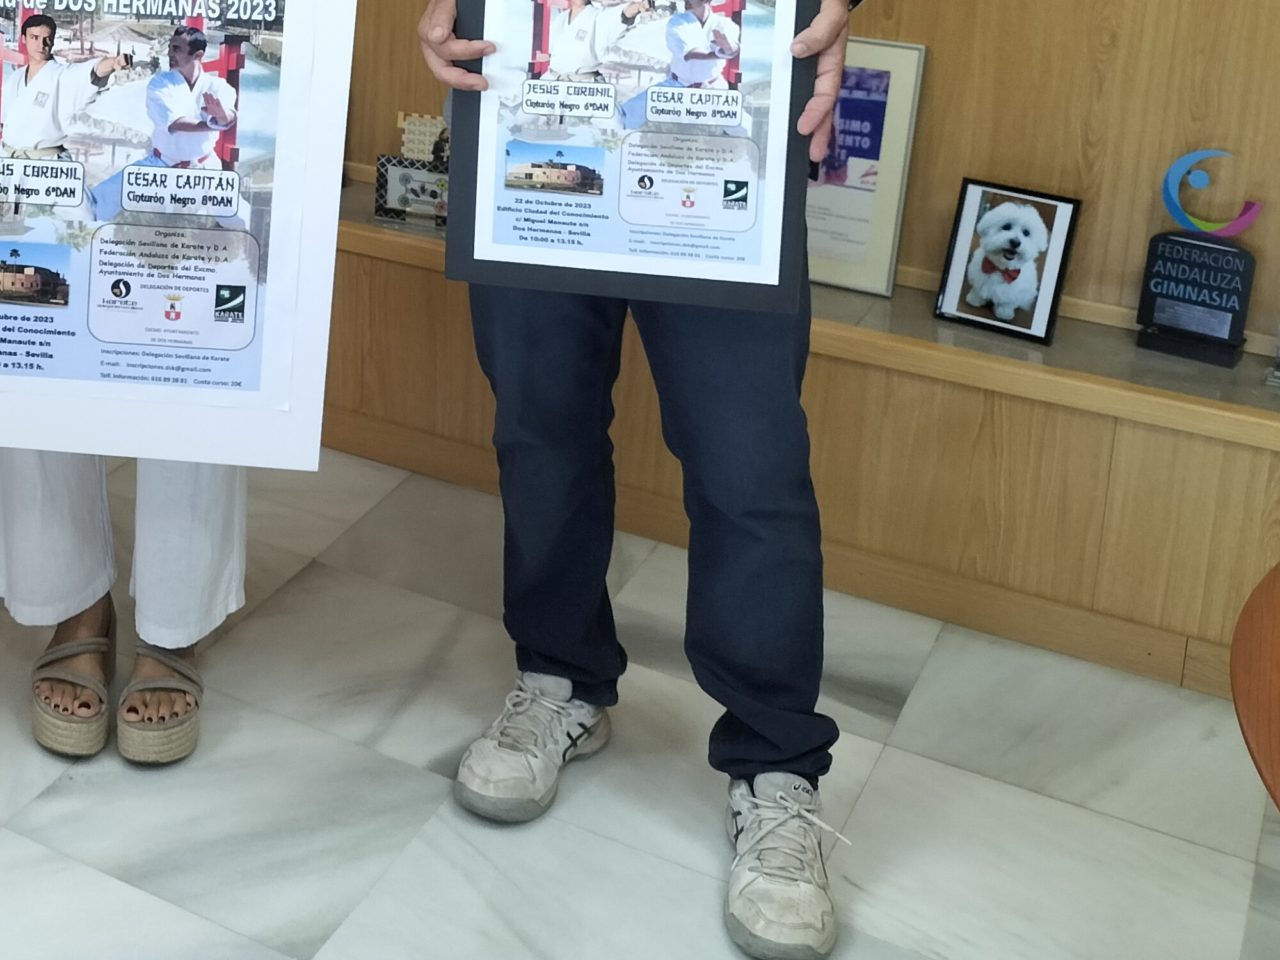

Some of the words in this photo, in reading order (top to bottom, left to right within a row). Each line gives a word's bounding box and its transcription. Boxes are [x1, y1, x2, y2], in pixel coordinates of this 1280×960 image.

[526, 83, 559, 95] JESÚS
[566, 86, 613, 98] CORONIL
[525, 99, 555, 110] Cinturón
[559, 101, 580, 111] Negro
[584, 102, 609, 112] 6ºDAN
[650, 91, 684, 104] CÉSAR
[690, 93, 738, 106] CAPITÁN
[650, 106, 681, 117] Cinturón
[686, 108, 707, 119] Negro
[711, 109, 737, 119] 8ºDAN
[23, 165, 81, 181] CORONIL
[127, 172, 168, 189] CÉSAR
[176, 175, 234, 192] CAPITÁN
[14, 184, 40, 198] Negro
[45, 186, 76, 198] 6ºDAN
[127, 191, 165, 205] Cinturón
[170, 193, 196, 207] Negro
[201, 195, 233, 207] 8ºDAN
[1157, 242, 1245, 272] FEDERACIÓN
[1152, 260, 1242, 291] ANDALUZA
[1150, 278, 1239, 310] GIMNASIA
[17, 326, 76, 337] Conocimiento
[0, 337, 36, 346] Manaute
[25, 351, 53, 359] Sevilla
[11, 362, 34, 370] 13.15
